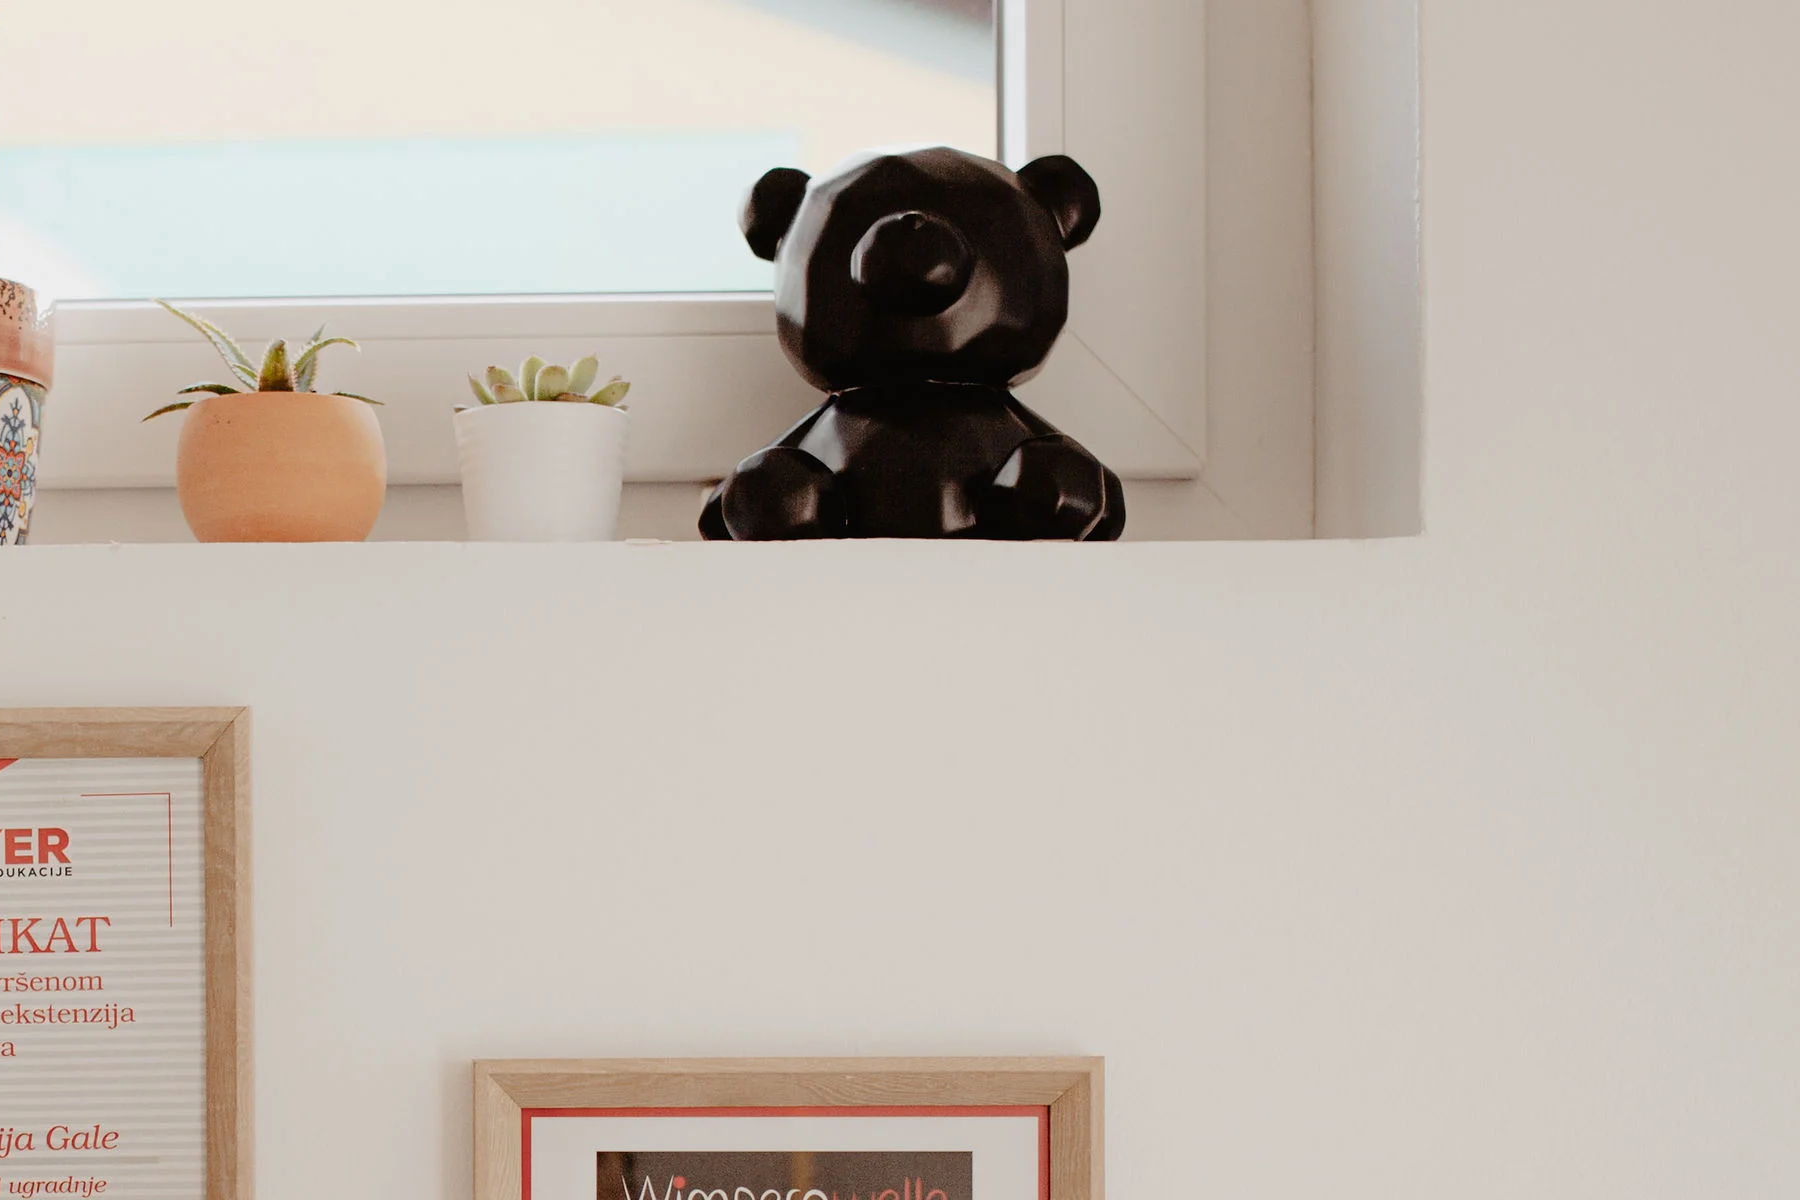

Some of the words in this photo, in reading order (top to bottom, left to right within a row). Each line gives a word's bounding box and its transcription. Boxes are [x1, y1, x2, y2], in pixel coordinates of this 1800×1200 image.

[0, 1002, 136, 1031] ekstenzija
[45, 1124, 119, 1152] Gale
[8, 1176, 107, 1200] ugradnje
